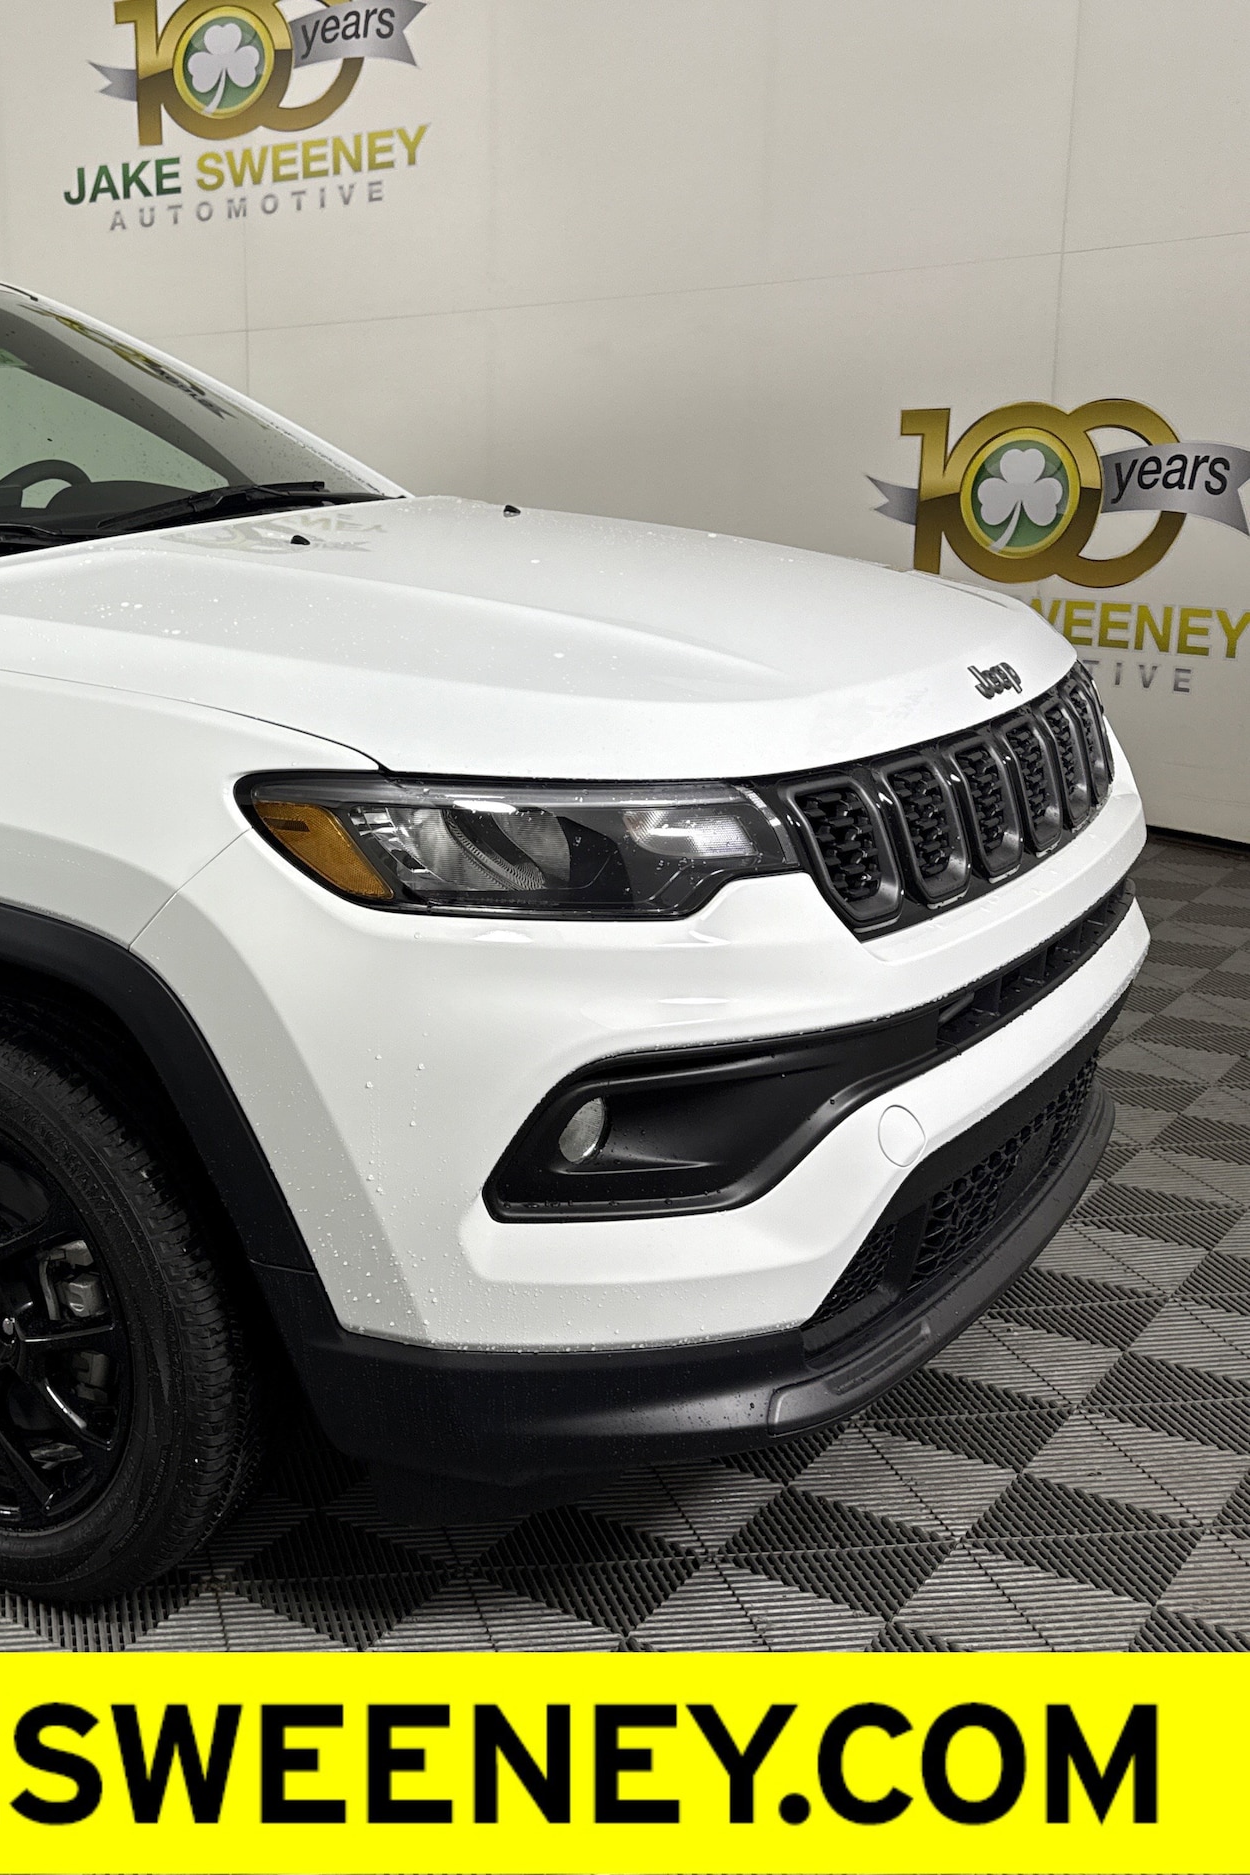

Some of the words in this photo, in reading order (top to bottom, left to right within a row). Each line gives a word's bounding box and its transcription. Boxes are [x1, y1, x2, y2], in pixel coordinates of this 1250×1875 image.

[300, 7, 396, 60] years
[63, 157, 182, 206] JAKE
[195, 125, 429, 192] SWEENEY
[109, 180, 385, 231] AUTOMOTIVE
[1110, 453, 1231, 505] years
[966, 661, 1023, 700] Jeep
